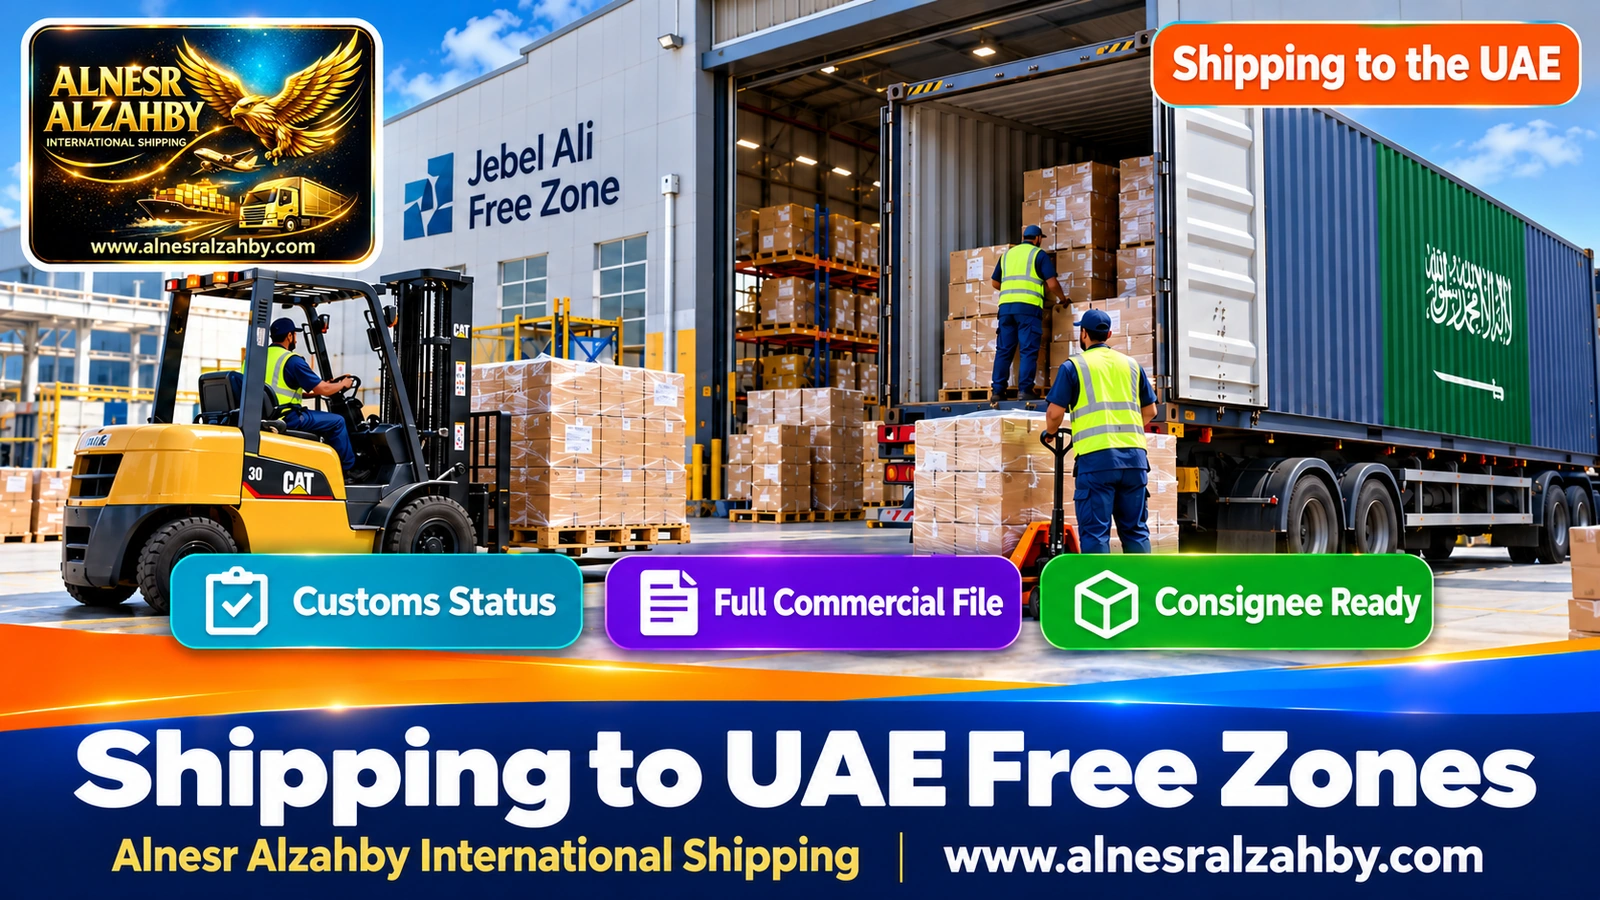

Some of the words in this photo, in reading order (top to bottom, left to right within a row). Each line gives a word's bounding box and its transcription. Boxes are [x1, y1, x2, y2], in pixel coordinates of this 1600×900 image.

[467, 133, 544, 187] Jebel
[551, 120, 594, 168] Ali
[469, 193, 532, 230] Free
[540, 176, 620, 218] Zone
[453, 323, 470, 339] CAT
[248, 466, 263, 481] 30
[283, 470, 315, 495] CAT
